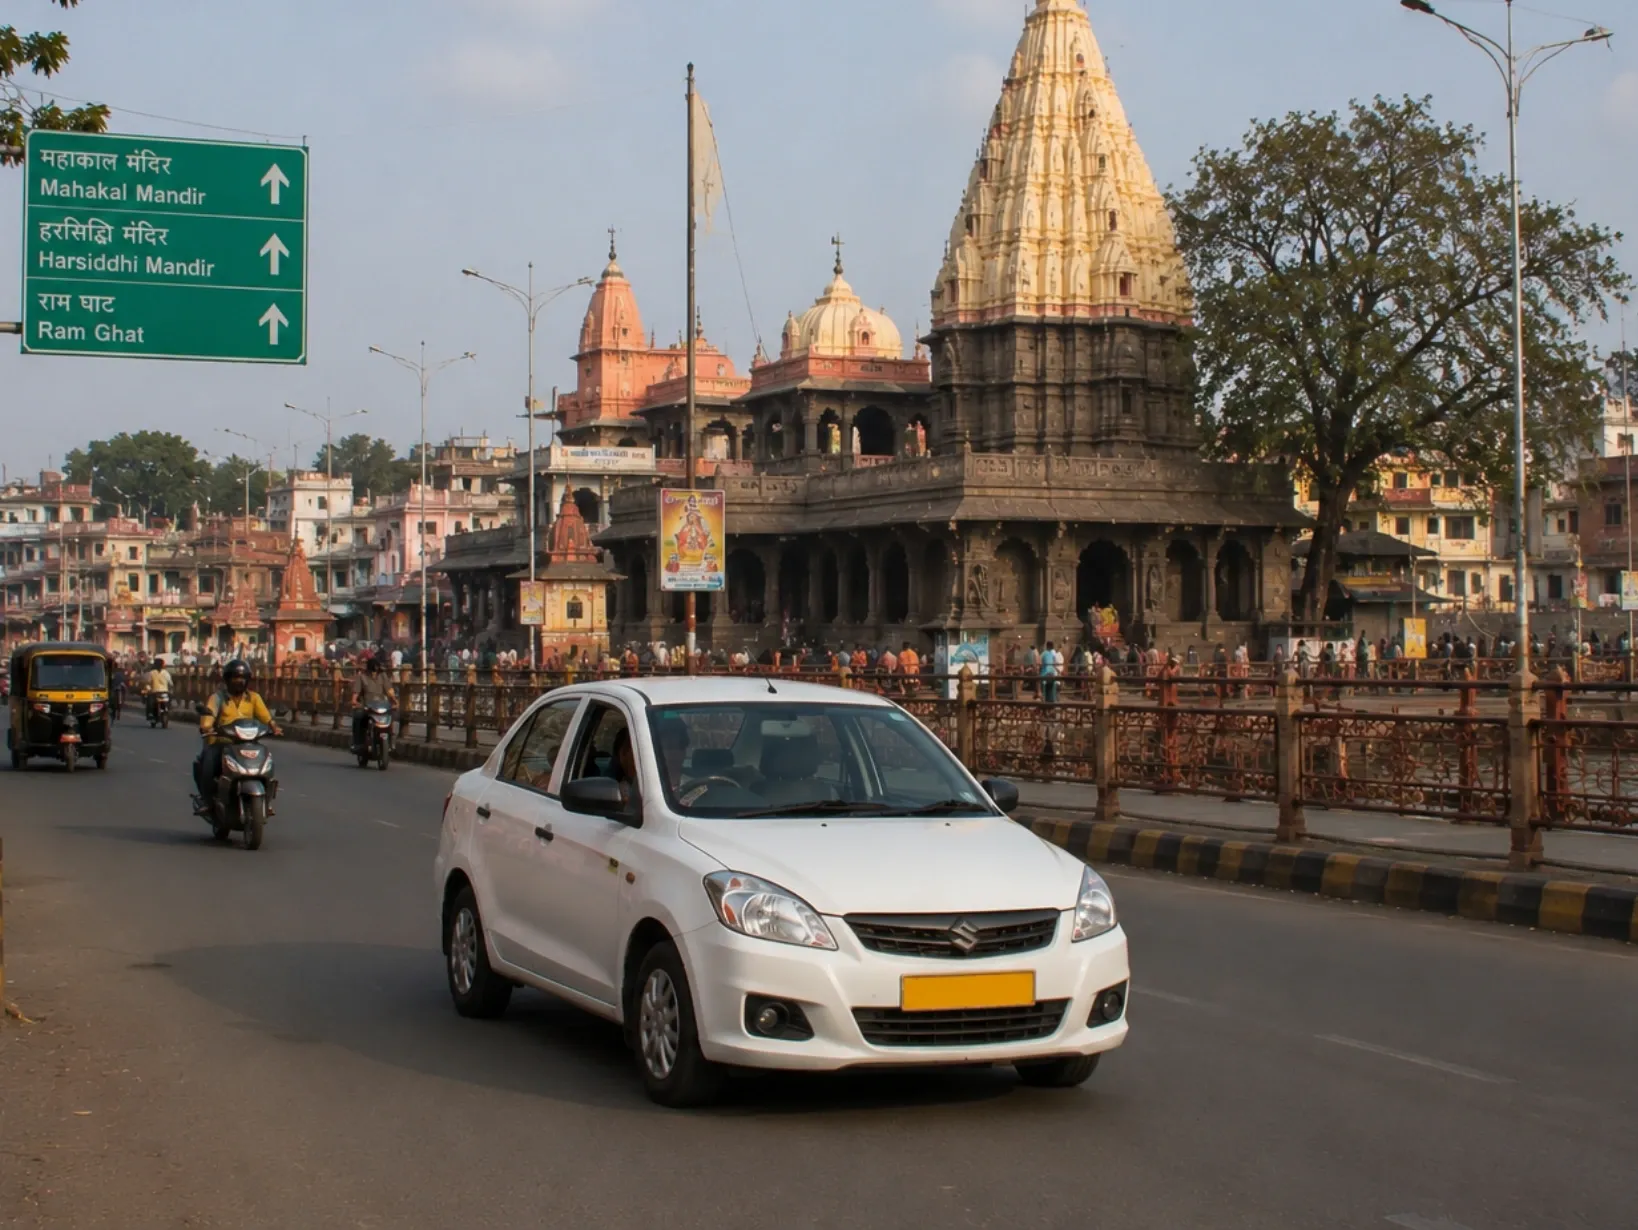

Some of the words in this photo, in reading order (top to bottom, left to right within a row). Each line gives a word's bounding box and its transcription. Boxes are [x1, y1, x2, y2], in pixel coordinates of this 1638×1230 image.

[40, 149, 118, 170] महाकाल
[126, 149, 172, 174] मंदिर
[40, 178, 126, 201] Mahakal
[136, 184, 206, 205] Mandir
[123, 220, 169, 246] मंदिर
[39, 251, 138, 273] Harsiddhi
[146, 256, 215, 277] Mandir
[38, 293, 72, 311] राम
[79, 295, 116, 313] घाट
[38, 320, 85, 340] Ram
[95, 323, 144, 343] Ghat
